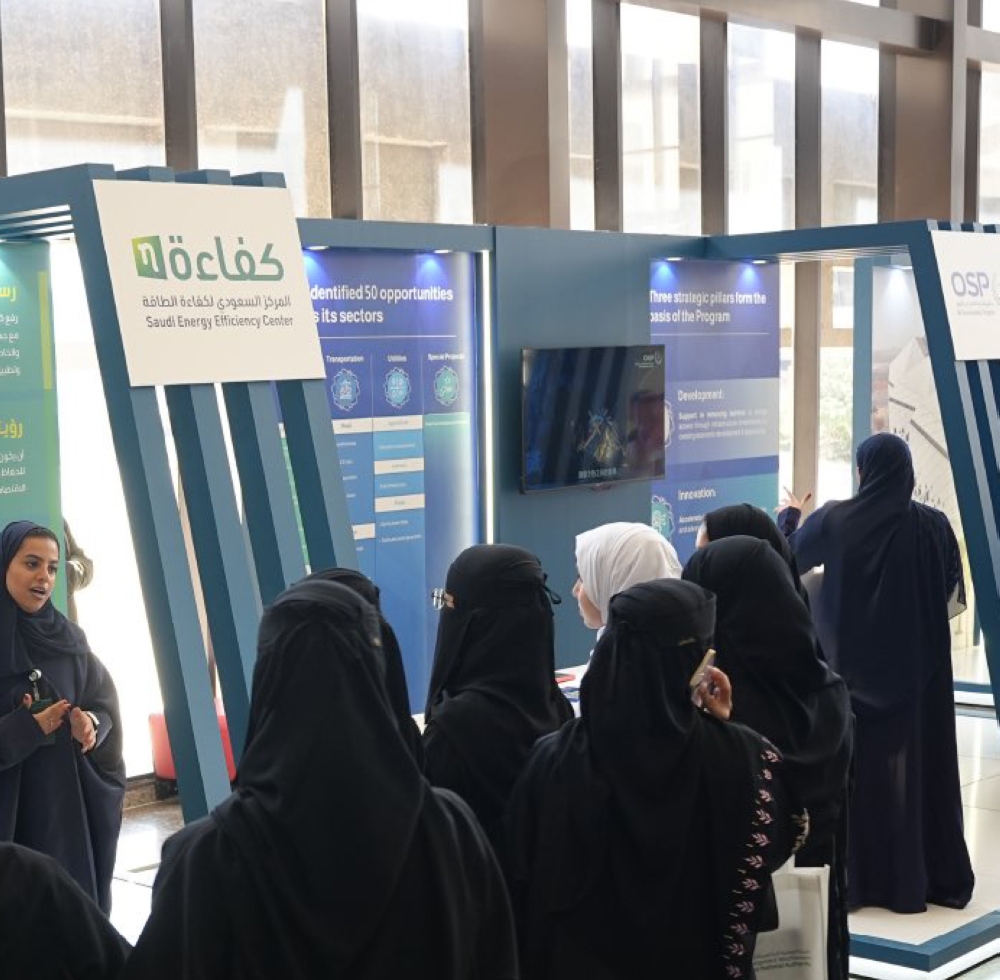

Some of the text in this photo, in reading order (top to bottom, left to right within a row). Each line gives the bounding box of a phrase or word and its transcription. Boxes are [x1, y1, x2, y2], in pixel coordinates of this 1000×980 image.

[168, 235, 285, 282] كفاءة
[951, 271, 989, 297] OSP
[310, 285, 454, 304] dentified 50 opportunities
[650, 290, 767, 307] Three strategic pillars form the
[142, 295, 292, 312] المركز السعودي لكفاءة الطاقة
[146, 314, 293, 330] Saudi Energy Efficiency Center
[321, 308, 338, 323] its
[339, 308, 384, 323] sectors
[672, 309, 681, 322] of
[681, 310, 695, 322] the
[696, 310, 731, 325] Program
